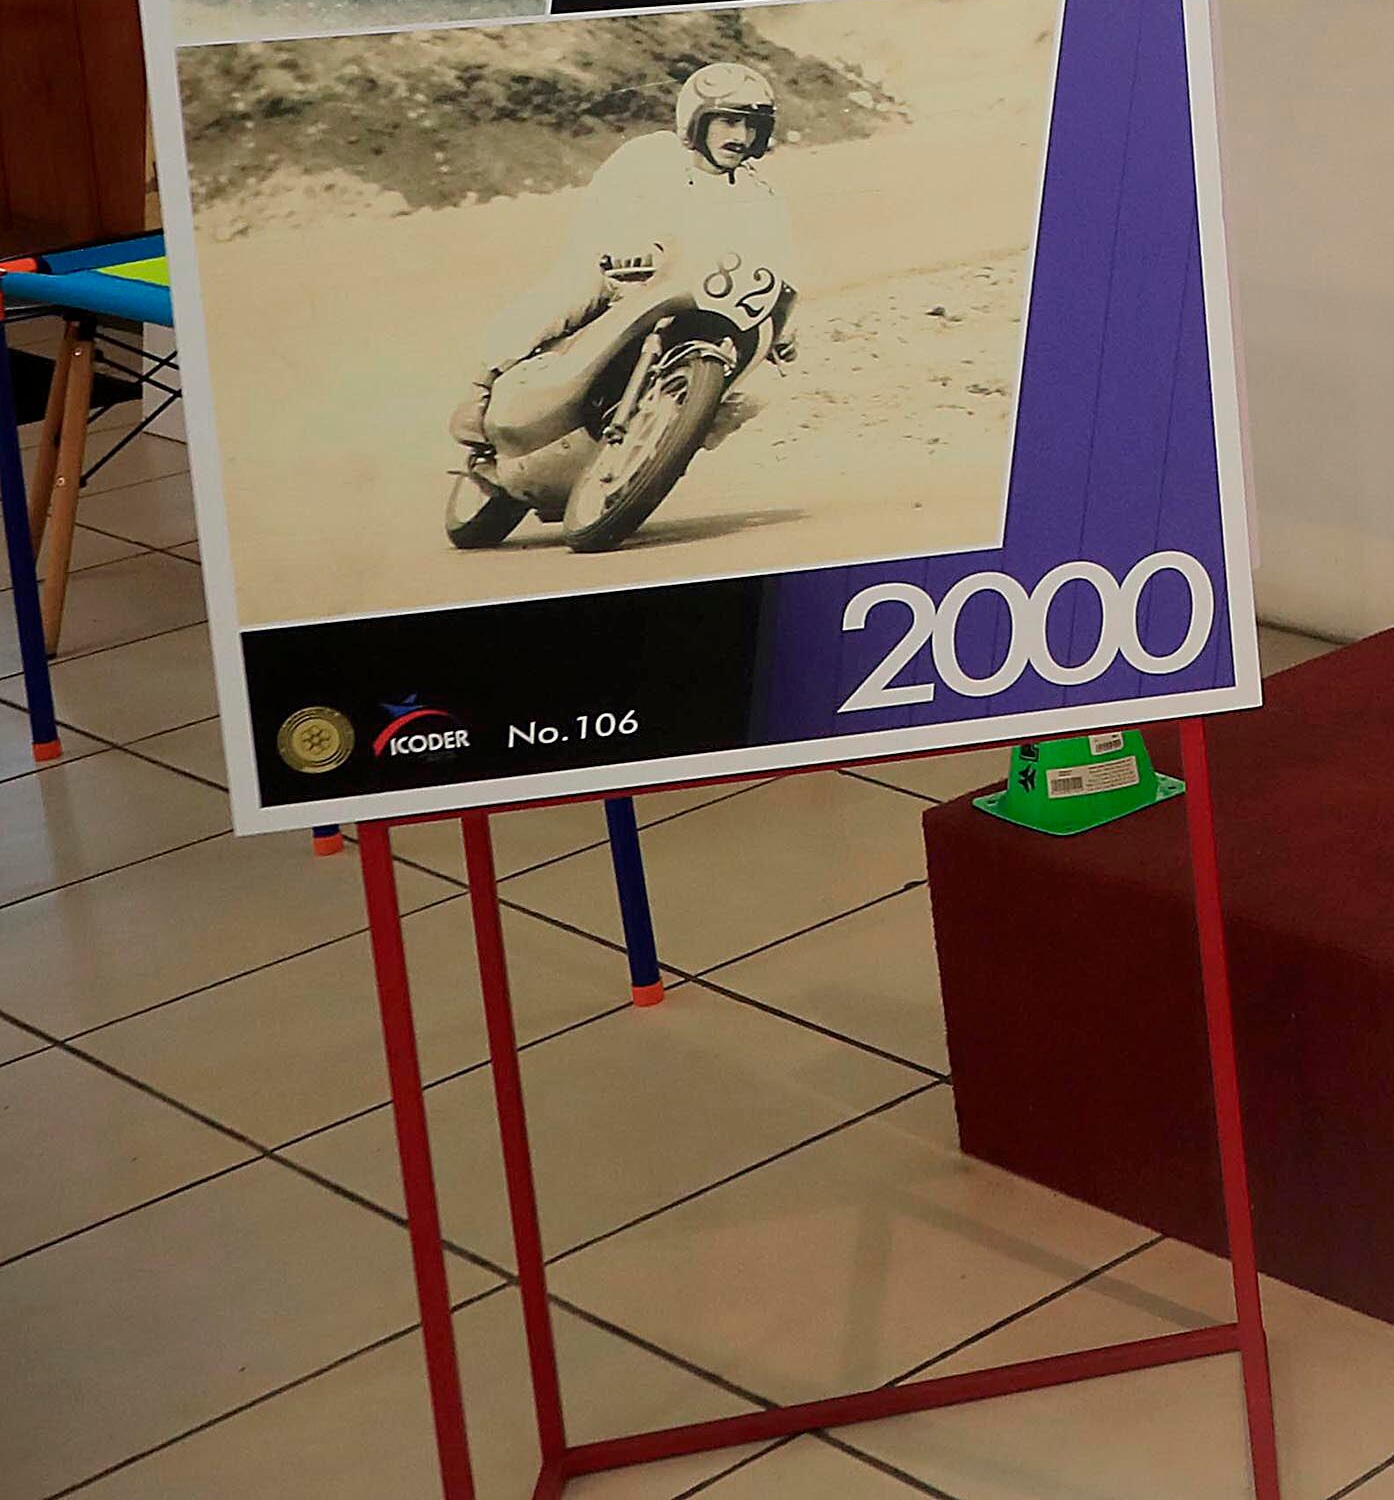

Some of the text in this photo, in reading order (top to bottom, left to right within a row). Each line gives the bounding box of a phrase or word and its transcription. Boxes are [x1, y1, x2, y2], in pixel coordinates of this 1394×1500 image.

[703, 252, 776, 317] 82
[837, 550, 1215, 714] 2000
[390, 729, 471, 756] ICODER
